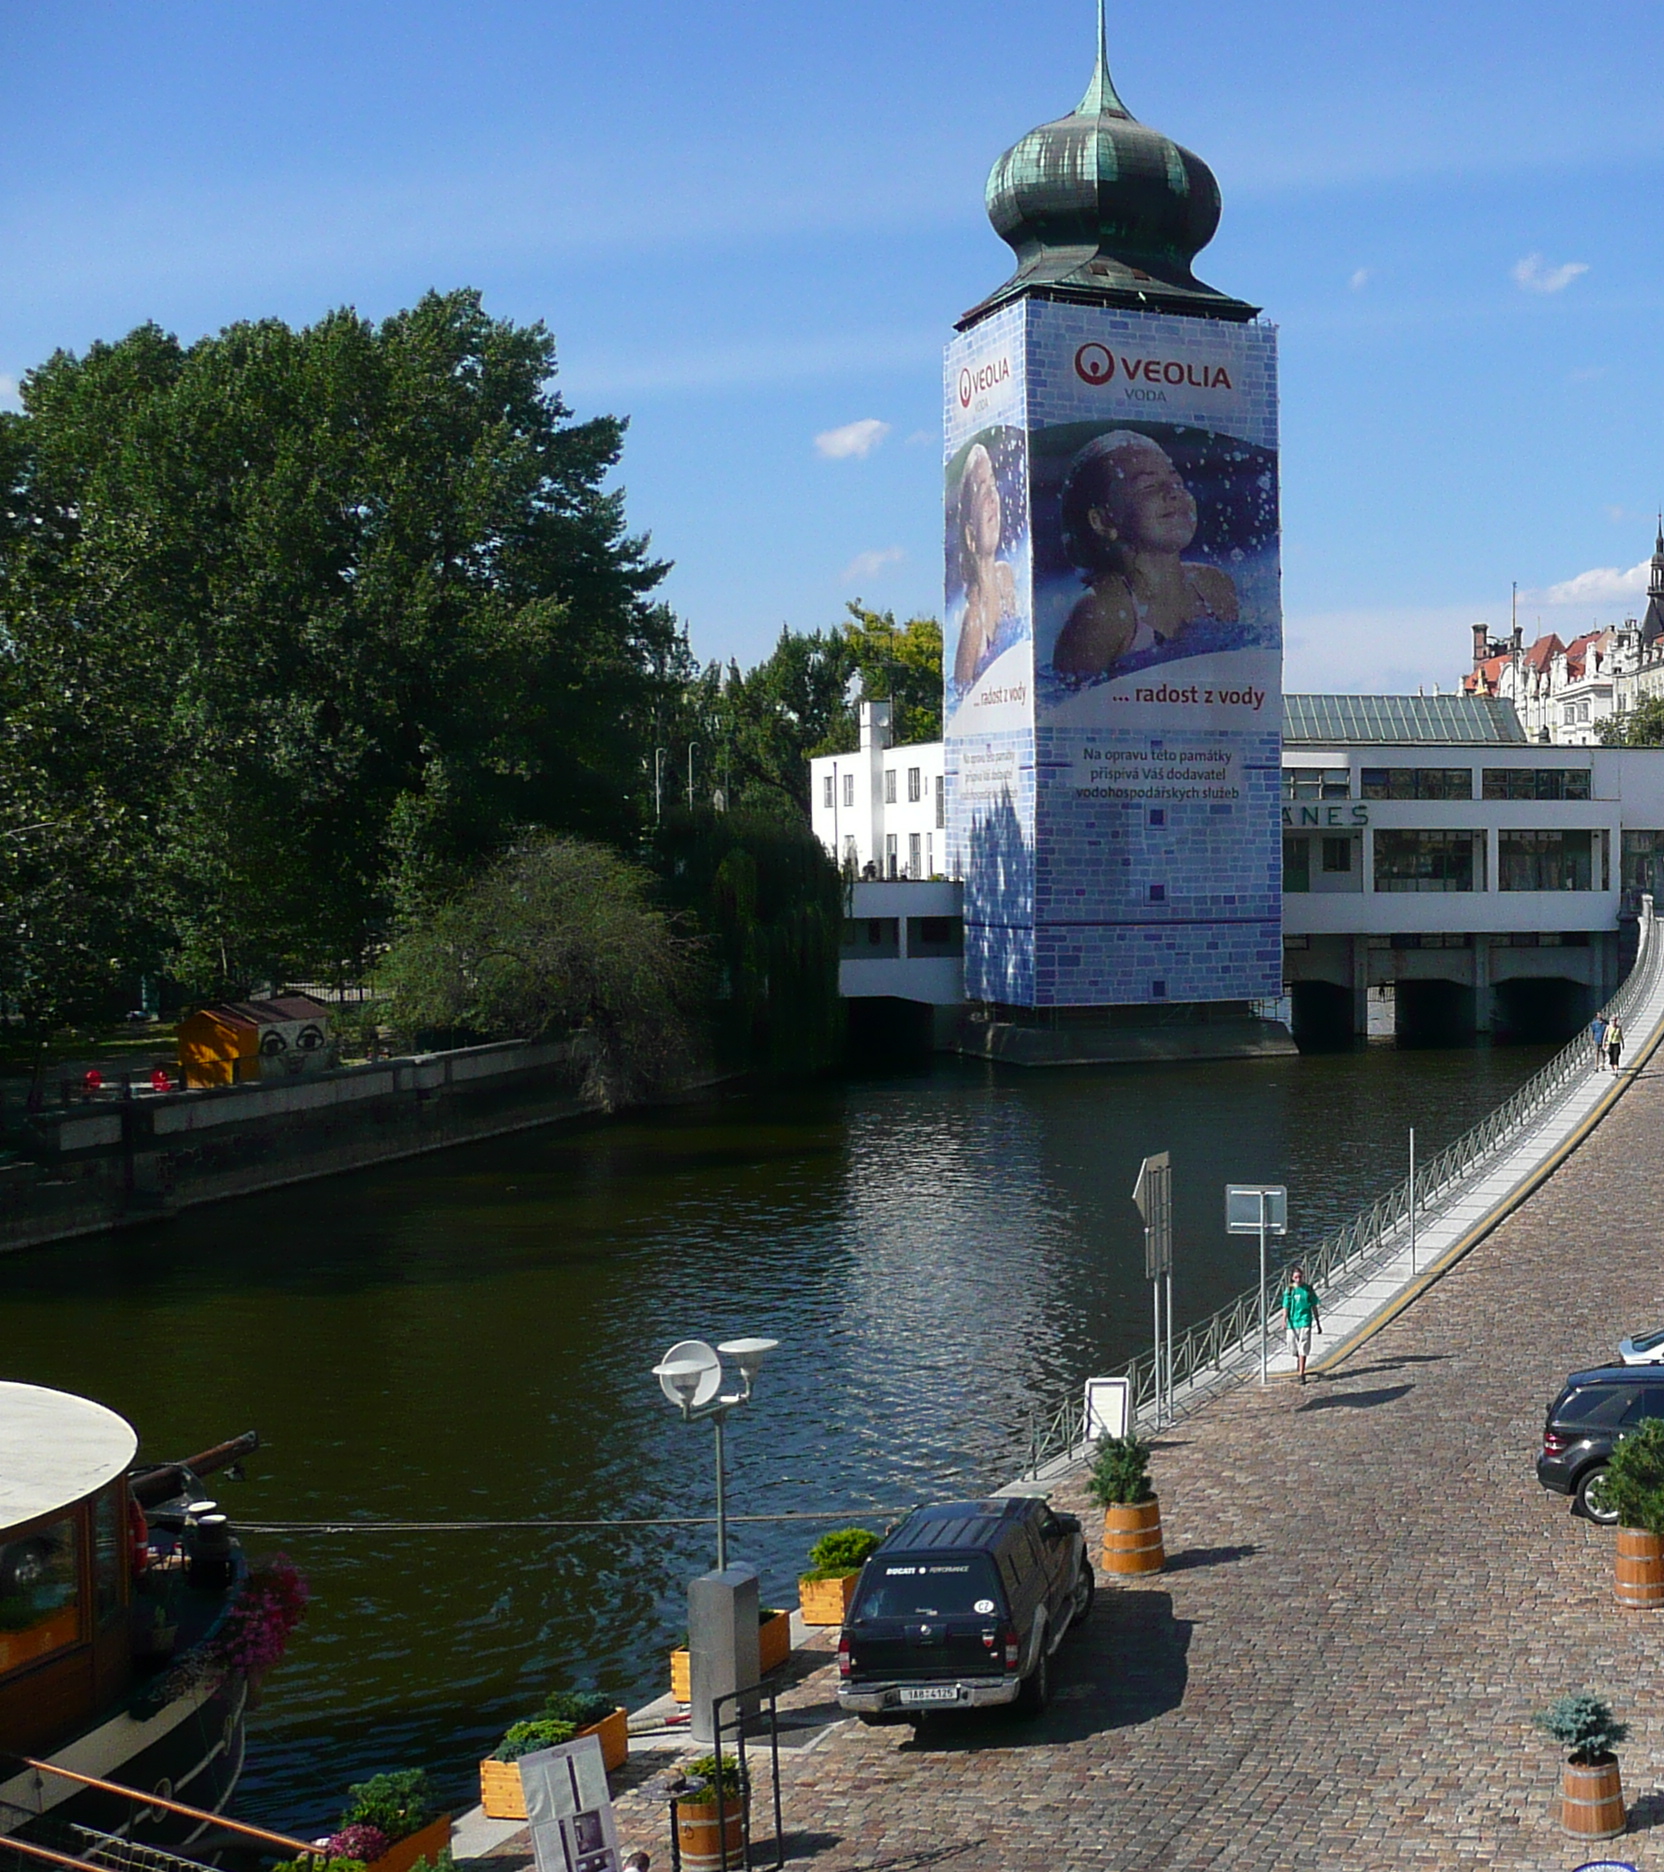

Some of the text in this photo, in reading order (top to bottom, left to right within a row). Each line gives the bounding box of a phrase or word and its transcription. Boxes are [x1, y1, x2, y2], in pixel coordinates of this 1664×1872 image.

[972, 357, 1010, 394] VEOLIA
[1121, 357, 1232, 389] VEOLIA
[1124, 388, 1167, 402] VODA
[1135, 683, 1198, 703] radost
[1204, 690, 1213, 704] z
[1218, 687, 1265, 710] vody
[1084, 748, 1232, 766] Na opravu této památky
[1090, 766, 1226, 783] přispívá Váš dodavatel
[1076, 785, 1239, 802] vodohospodářských služeb
[978, 1602, 990, 1611] CZ
